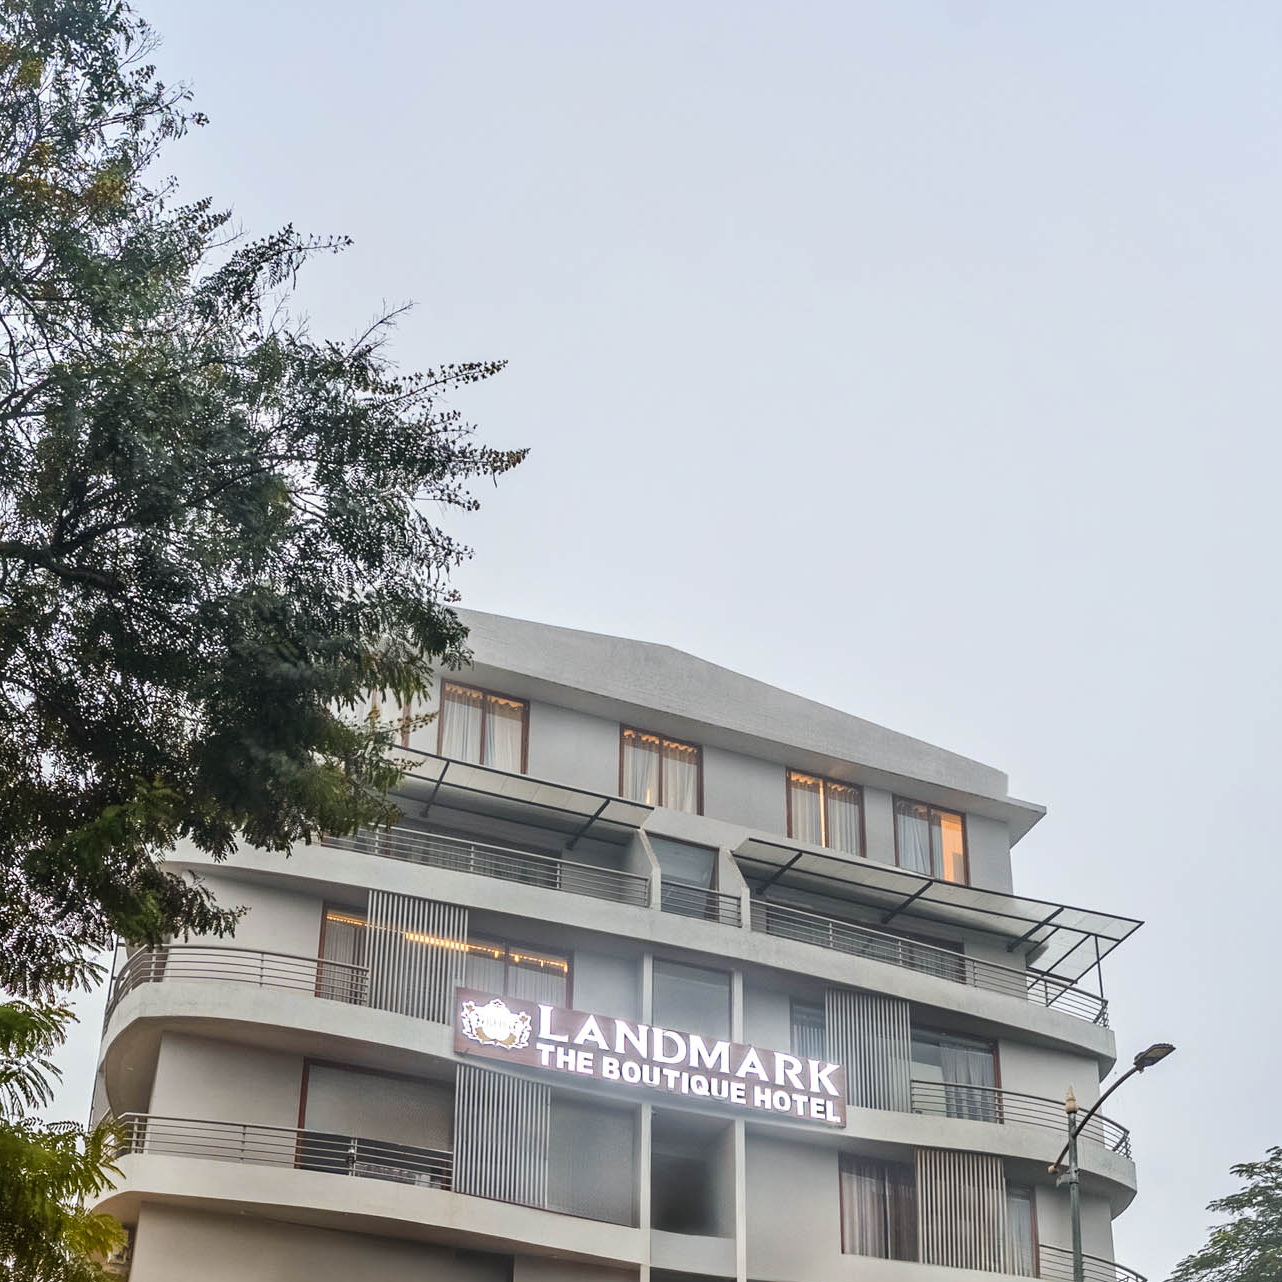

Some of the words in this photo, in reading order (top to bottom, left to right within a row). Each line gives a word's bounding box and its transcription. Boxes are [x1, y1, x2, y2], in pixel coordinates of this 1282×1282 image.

[536, 1004, 841, 1096] LANDMARK
[537, 1044, 594, 1075] THE
[602, 1056, 747, 1104] BOUTIQUE
[755, 1088, 841, 1123] HOTEL
